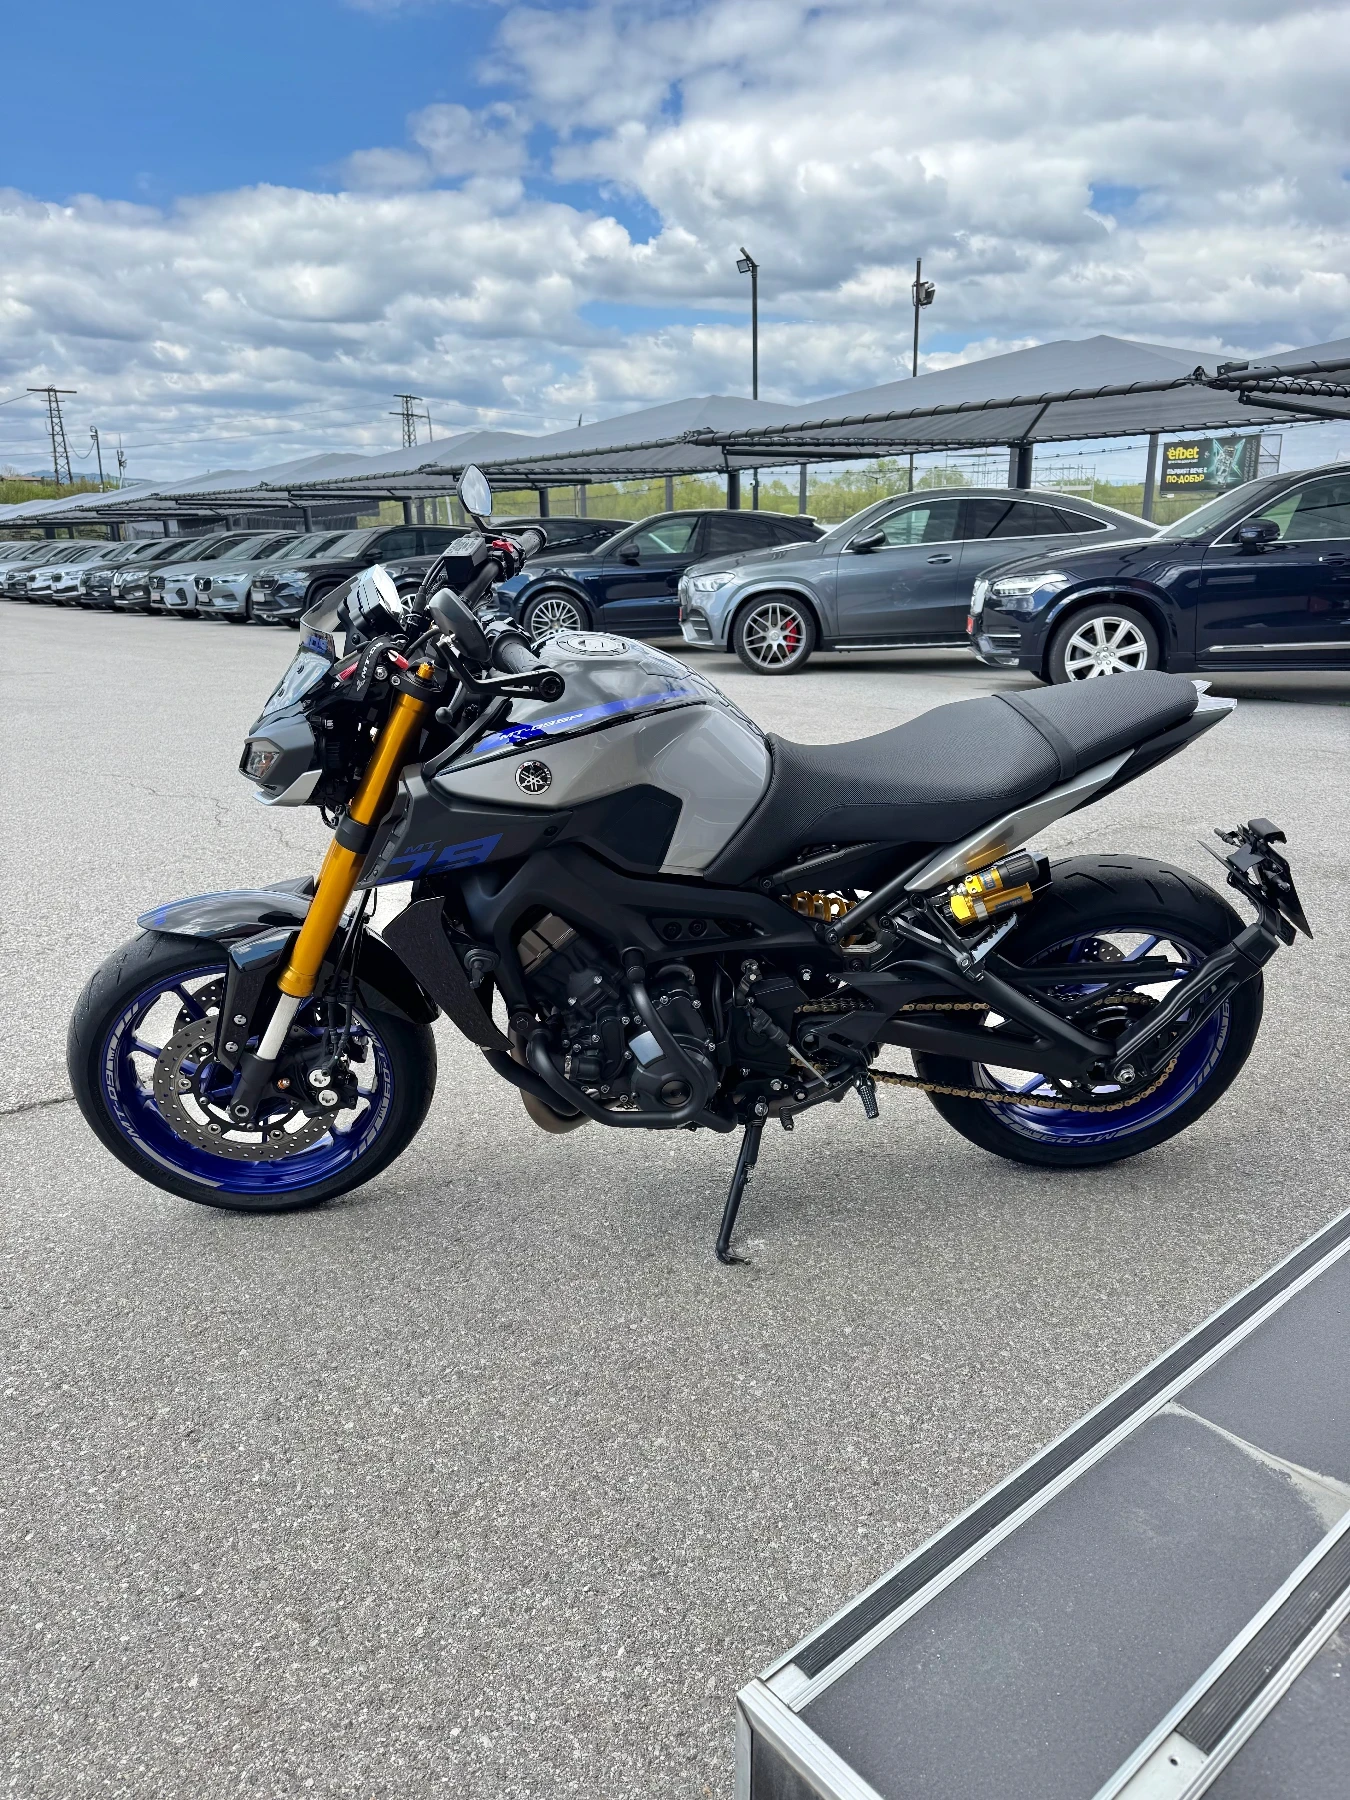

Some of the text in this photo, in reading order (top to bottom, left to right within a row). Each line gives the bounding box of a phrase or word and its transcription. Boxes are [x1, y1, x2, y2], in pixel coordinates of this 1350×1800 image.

[1167, 446, 1199, 460] efbet
[1166, 474, 1205, 484] ПО-ДОБЪР
[404, 839, 442, 854] MT
[105, 1072, 140, 1138] MT-09
